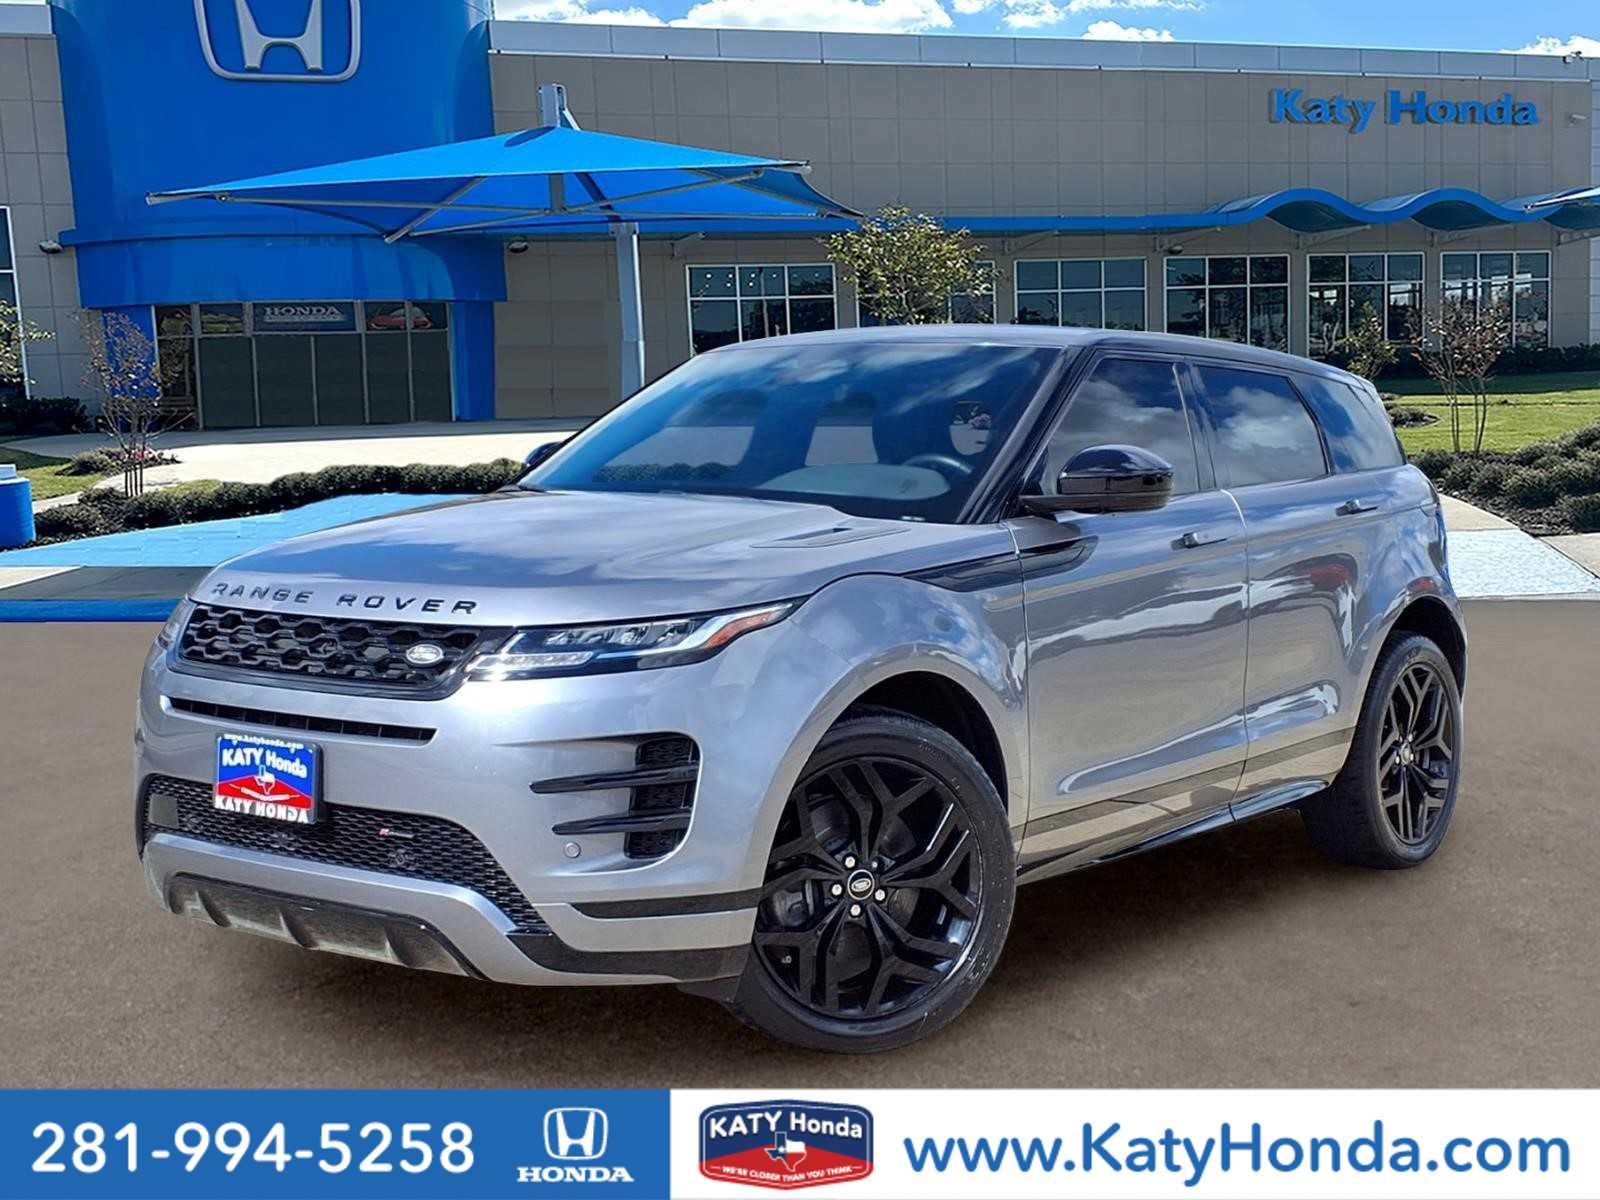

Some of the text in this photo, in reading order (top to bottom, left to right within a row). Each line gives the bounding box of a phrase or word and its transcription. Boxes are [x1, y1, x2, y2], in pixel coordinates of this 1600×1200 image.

[1269, 88, 1539, 134] Katy Honda
[263, 306, 343, 319] HONDA
[211, 583, 477, 615] RANGE ROVER
[222, 748, 308, 778] KATY Honda
[214, 795, 309, 824] KATY HONDA
